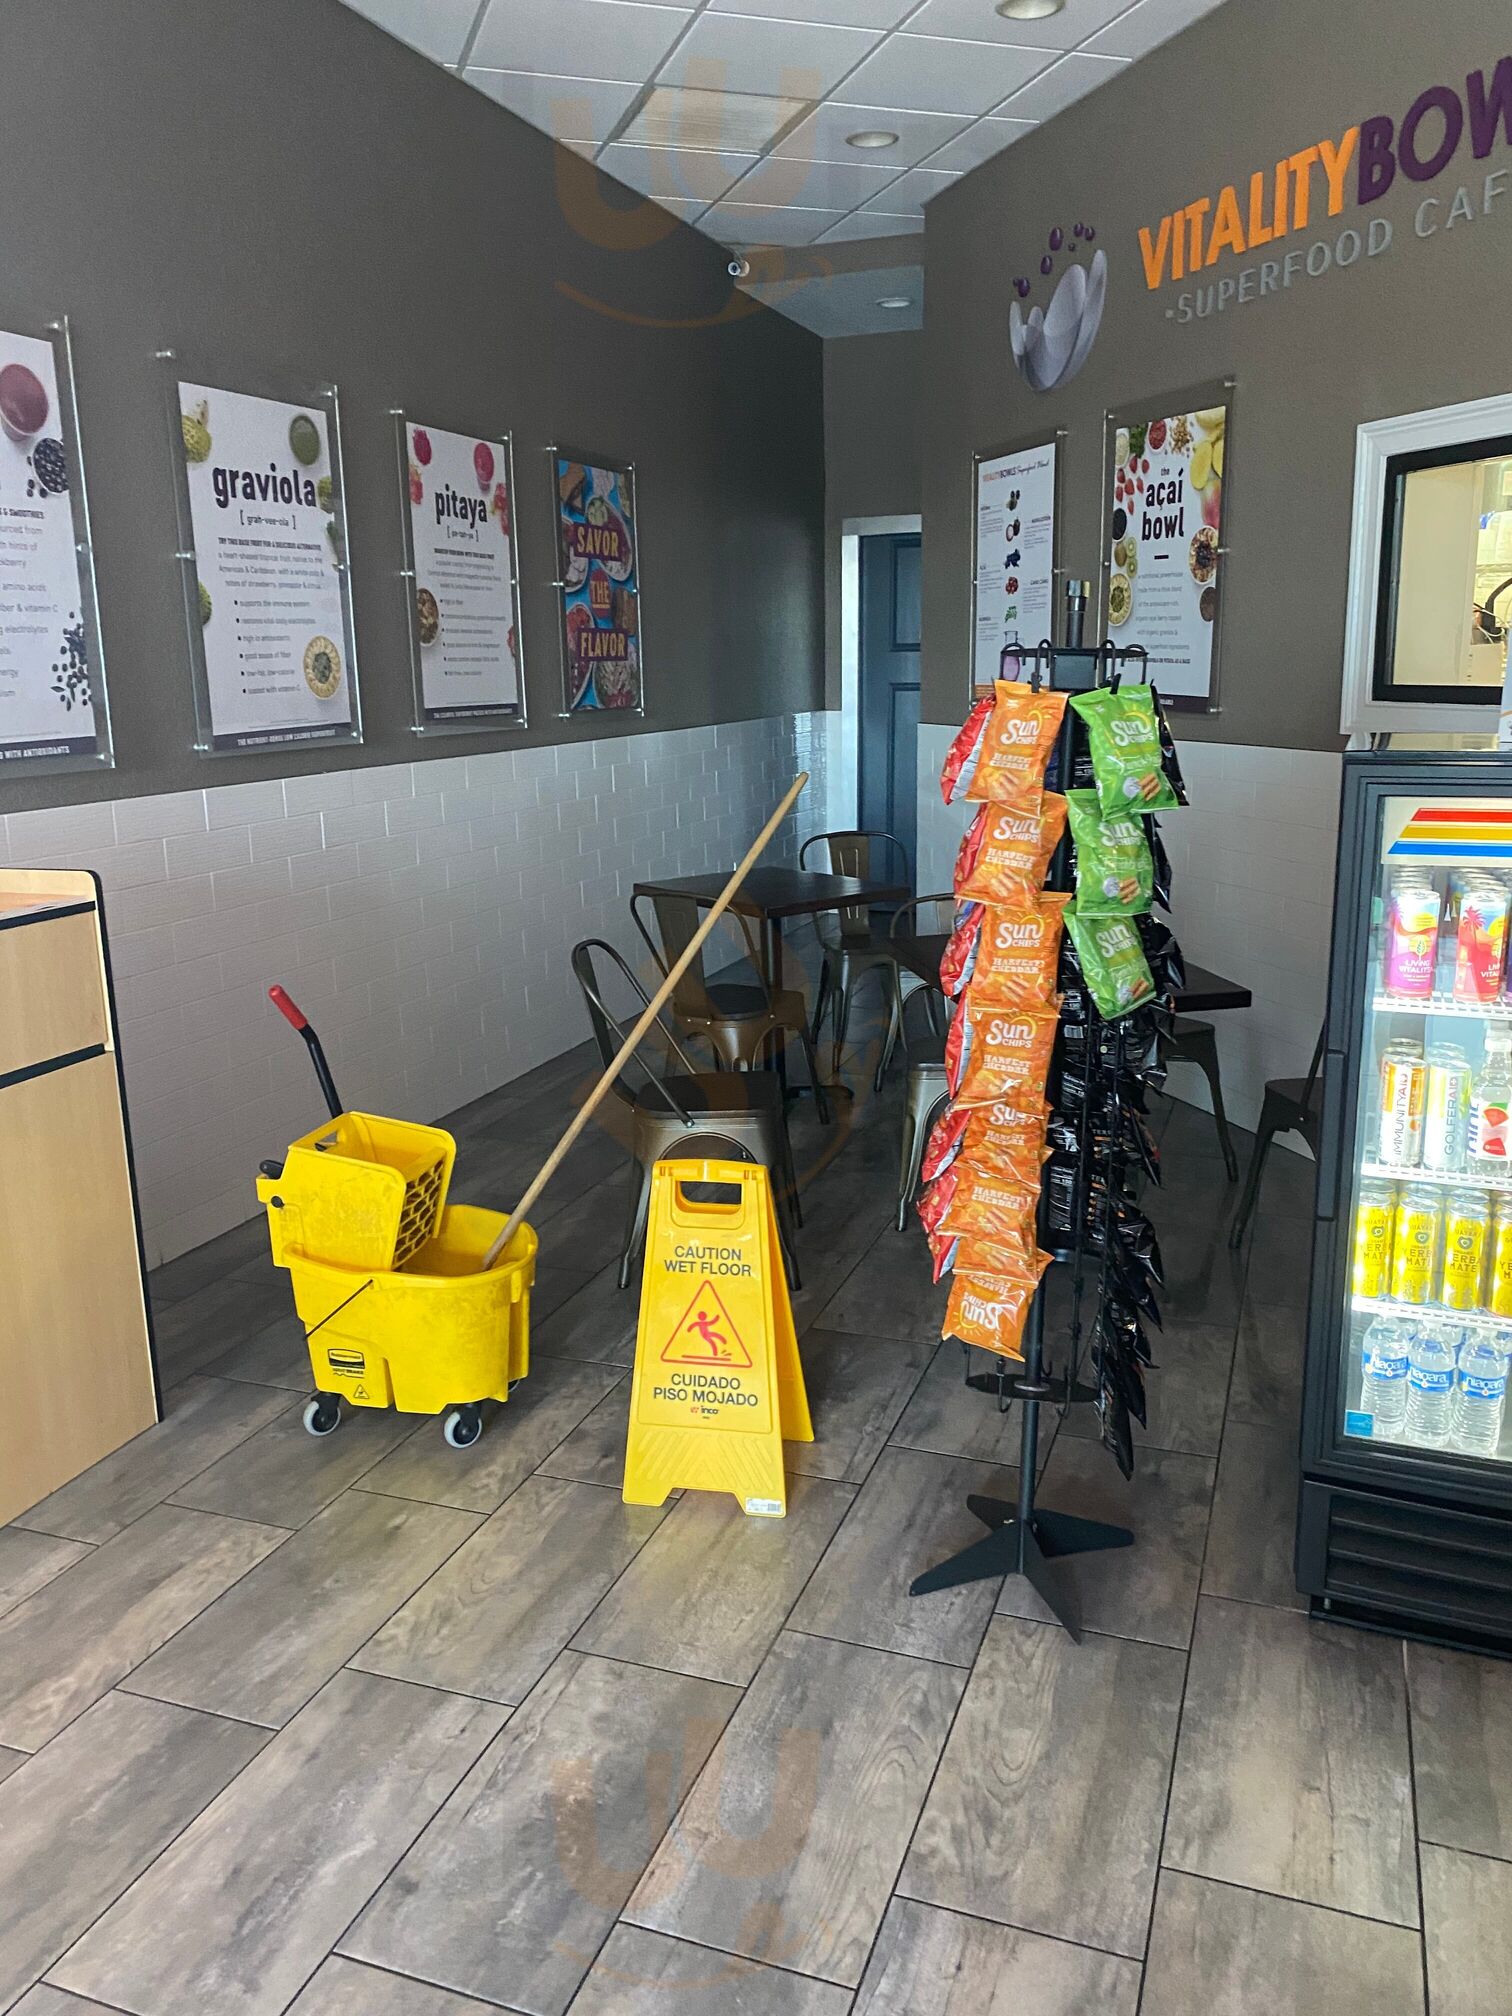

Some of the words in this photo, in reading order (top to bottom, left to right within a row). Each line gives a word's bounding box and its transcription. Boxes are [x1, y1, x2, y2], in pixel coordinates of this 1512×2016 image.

[1176, 218, 1393, 323] SUPERFOOD
[212, 463, 316, 508] graviola
[1146, 468, 1184, 510] açaí
[434, 484, 487, 529] pitaya
[1142, 507, 1184, 540] bowl
[577, 528, 620, 557] SAVOR
[590, 580, 612, 601] THE
[580, 632, 626, 658] FLAVOR
[1000, 719, 1040, 744] Sun
[1111, 721, 1150, 746] Sun
[993, 816, 1040, 840] Sun
[1099, 822, 1139, 846] Sun
[995, 922, 1042, 948] Sun
[1012, 939, 1040, 948] CHIPS
[1096, 925, 1130, 958] Sun
[993, 958, 1042, 968] HARVEST
[986, 1020, 1036, 1045] Sun
[1002, 1038, 1032, 1048] CHIPS
[984, 1054, 1032, 1069] HARVEST
[1394, 1073, 1408, 1155] IMMUNITYAID
[972, 1194, 1020, 1210] CHEDDAR
[973, 1186, 1023, 1203] HARVEST
[674, 1246, 741, 1261] CAUTION
[664, 1259, 696, 1274] WET
[701, 1262, 751, 1277] FLOOR
[961, 1300, 1001, 1329] Sun
[671, 1373, 741, 1390] CUIDADO
[653, 1387, 688, 1401] PISO
[693, 1390, 758, 1406] MOJADO
[701, 1406, 718, 1414] inco
